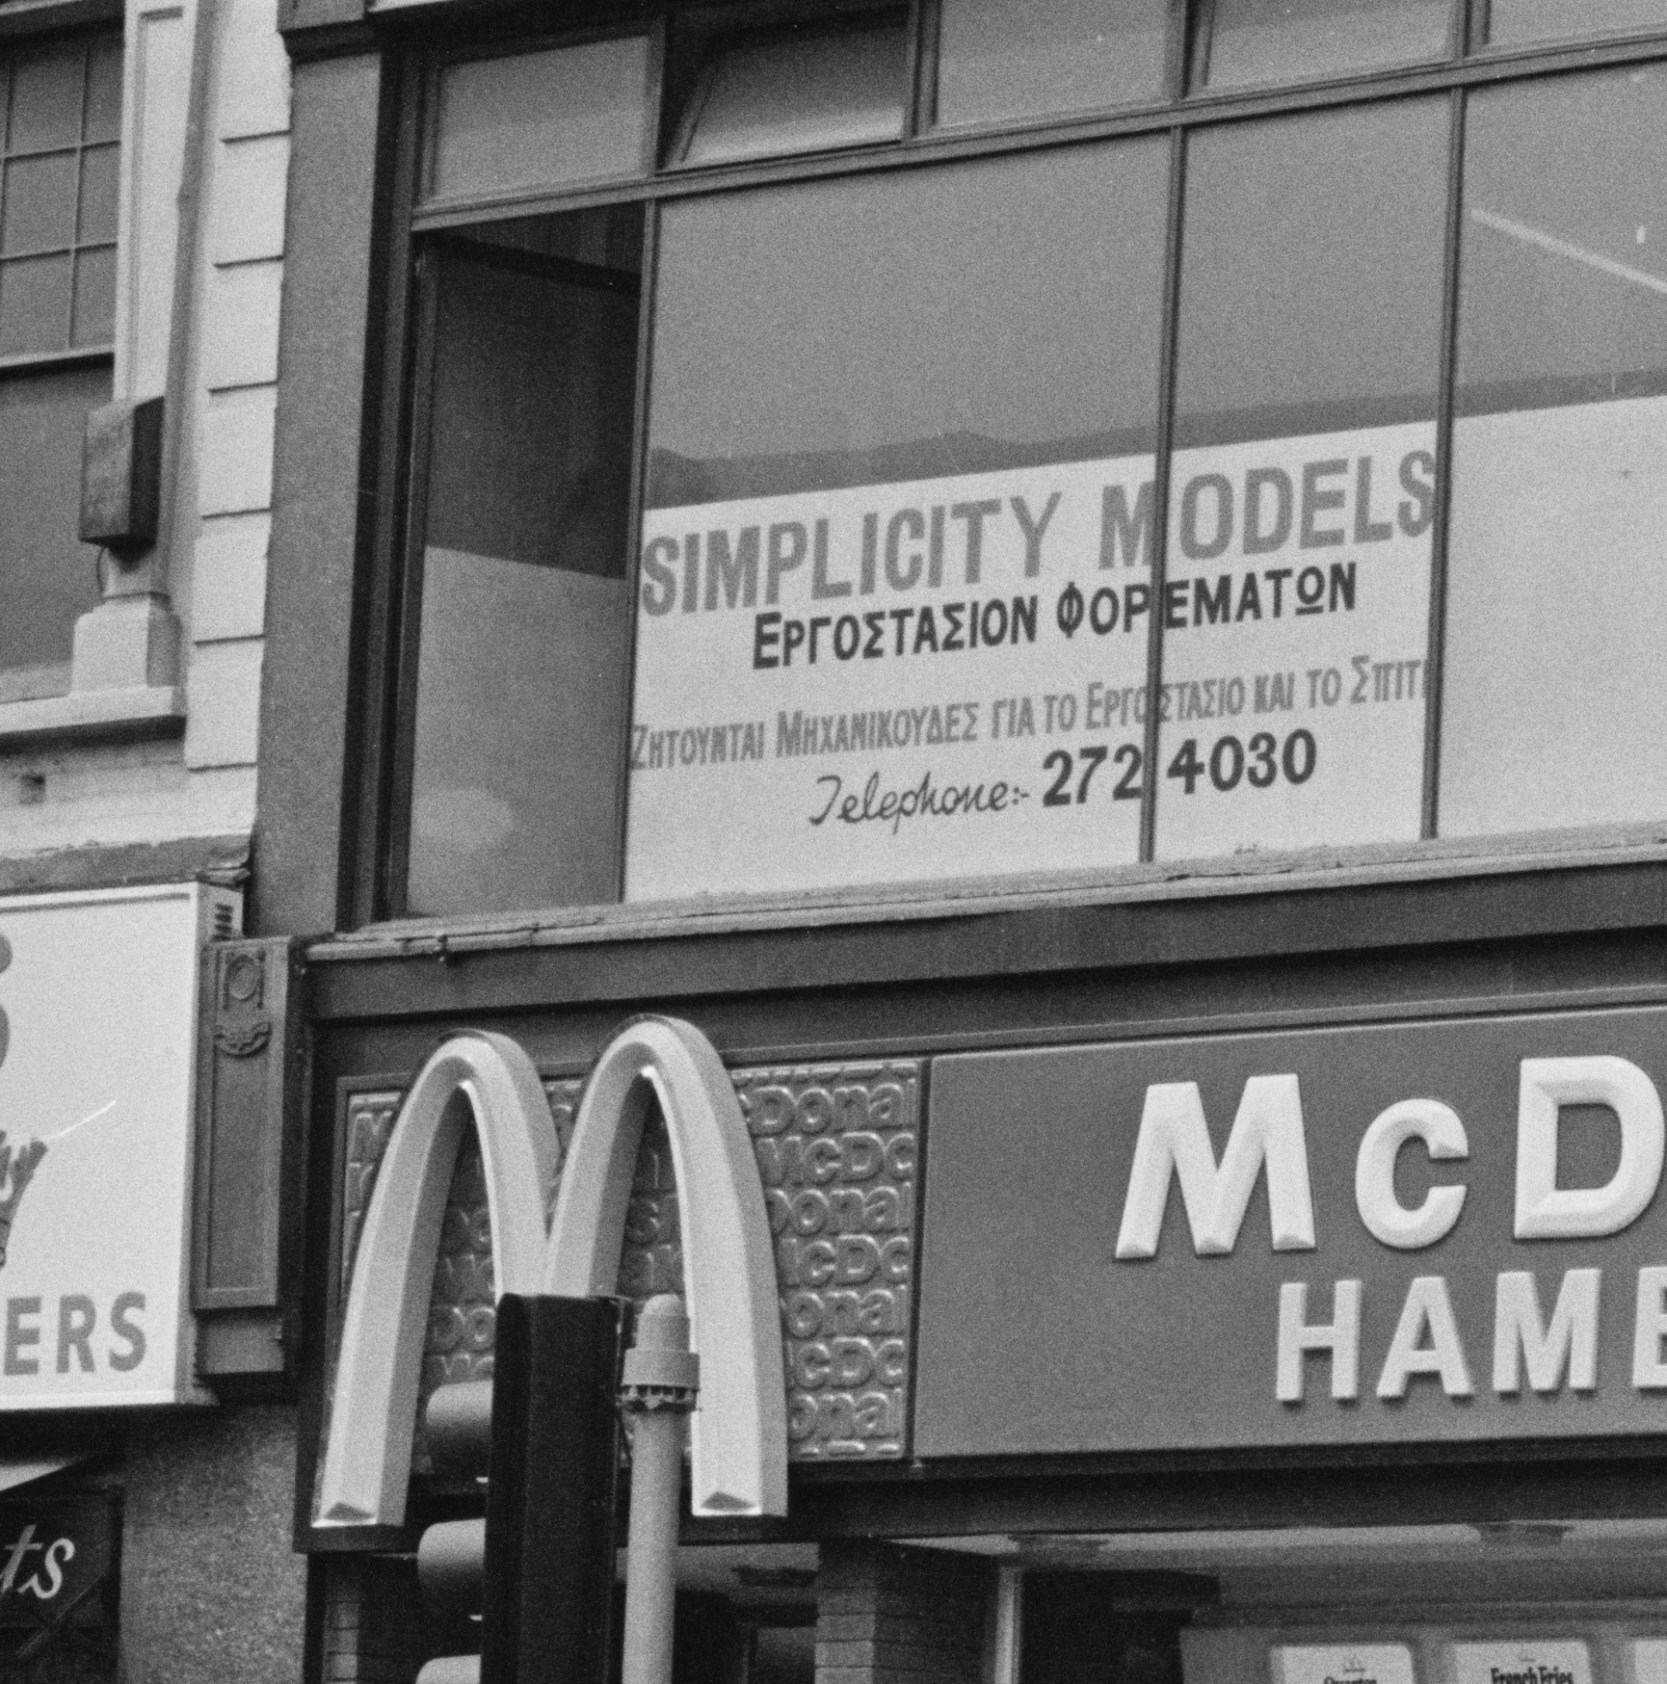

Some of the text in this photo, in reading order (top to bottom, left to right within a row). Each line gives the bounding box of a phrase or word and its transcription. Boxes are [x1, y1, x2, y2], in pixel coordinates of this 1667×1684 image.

[643, 449, 1436, 616] SIMPLICITY MODELS
[1042, 744, 1144, 807] 272
[1167, 729, 1316, 794] 4030
